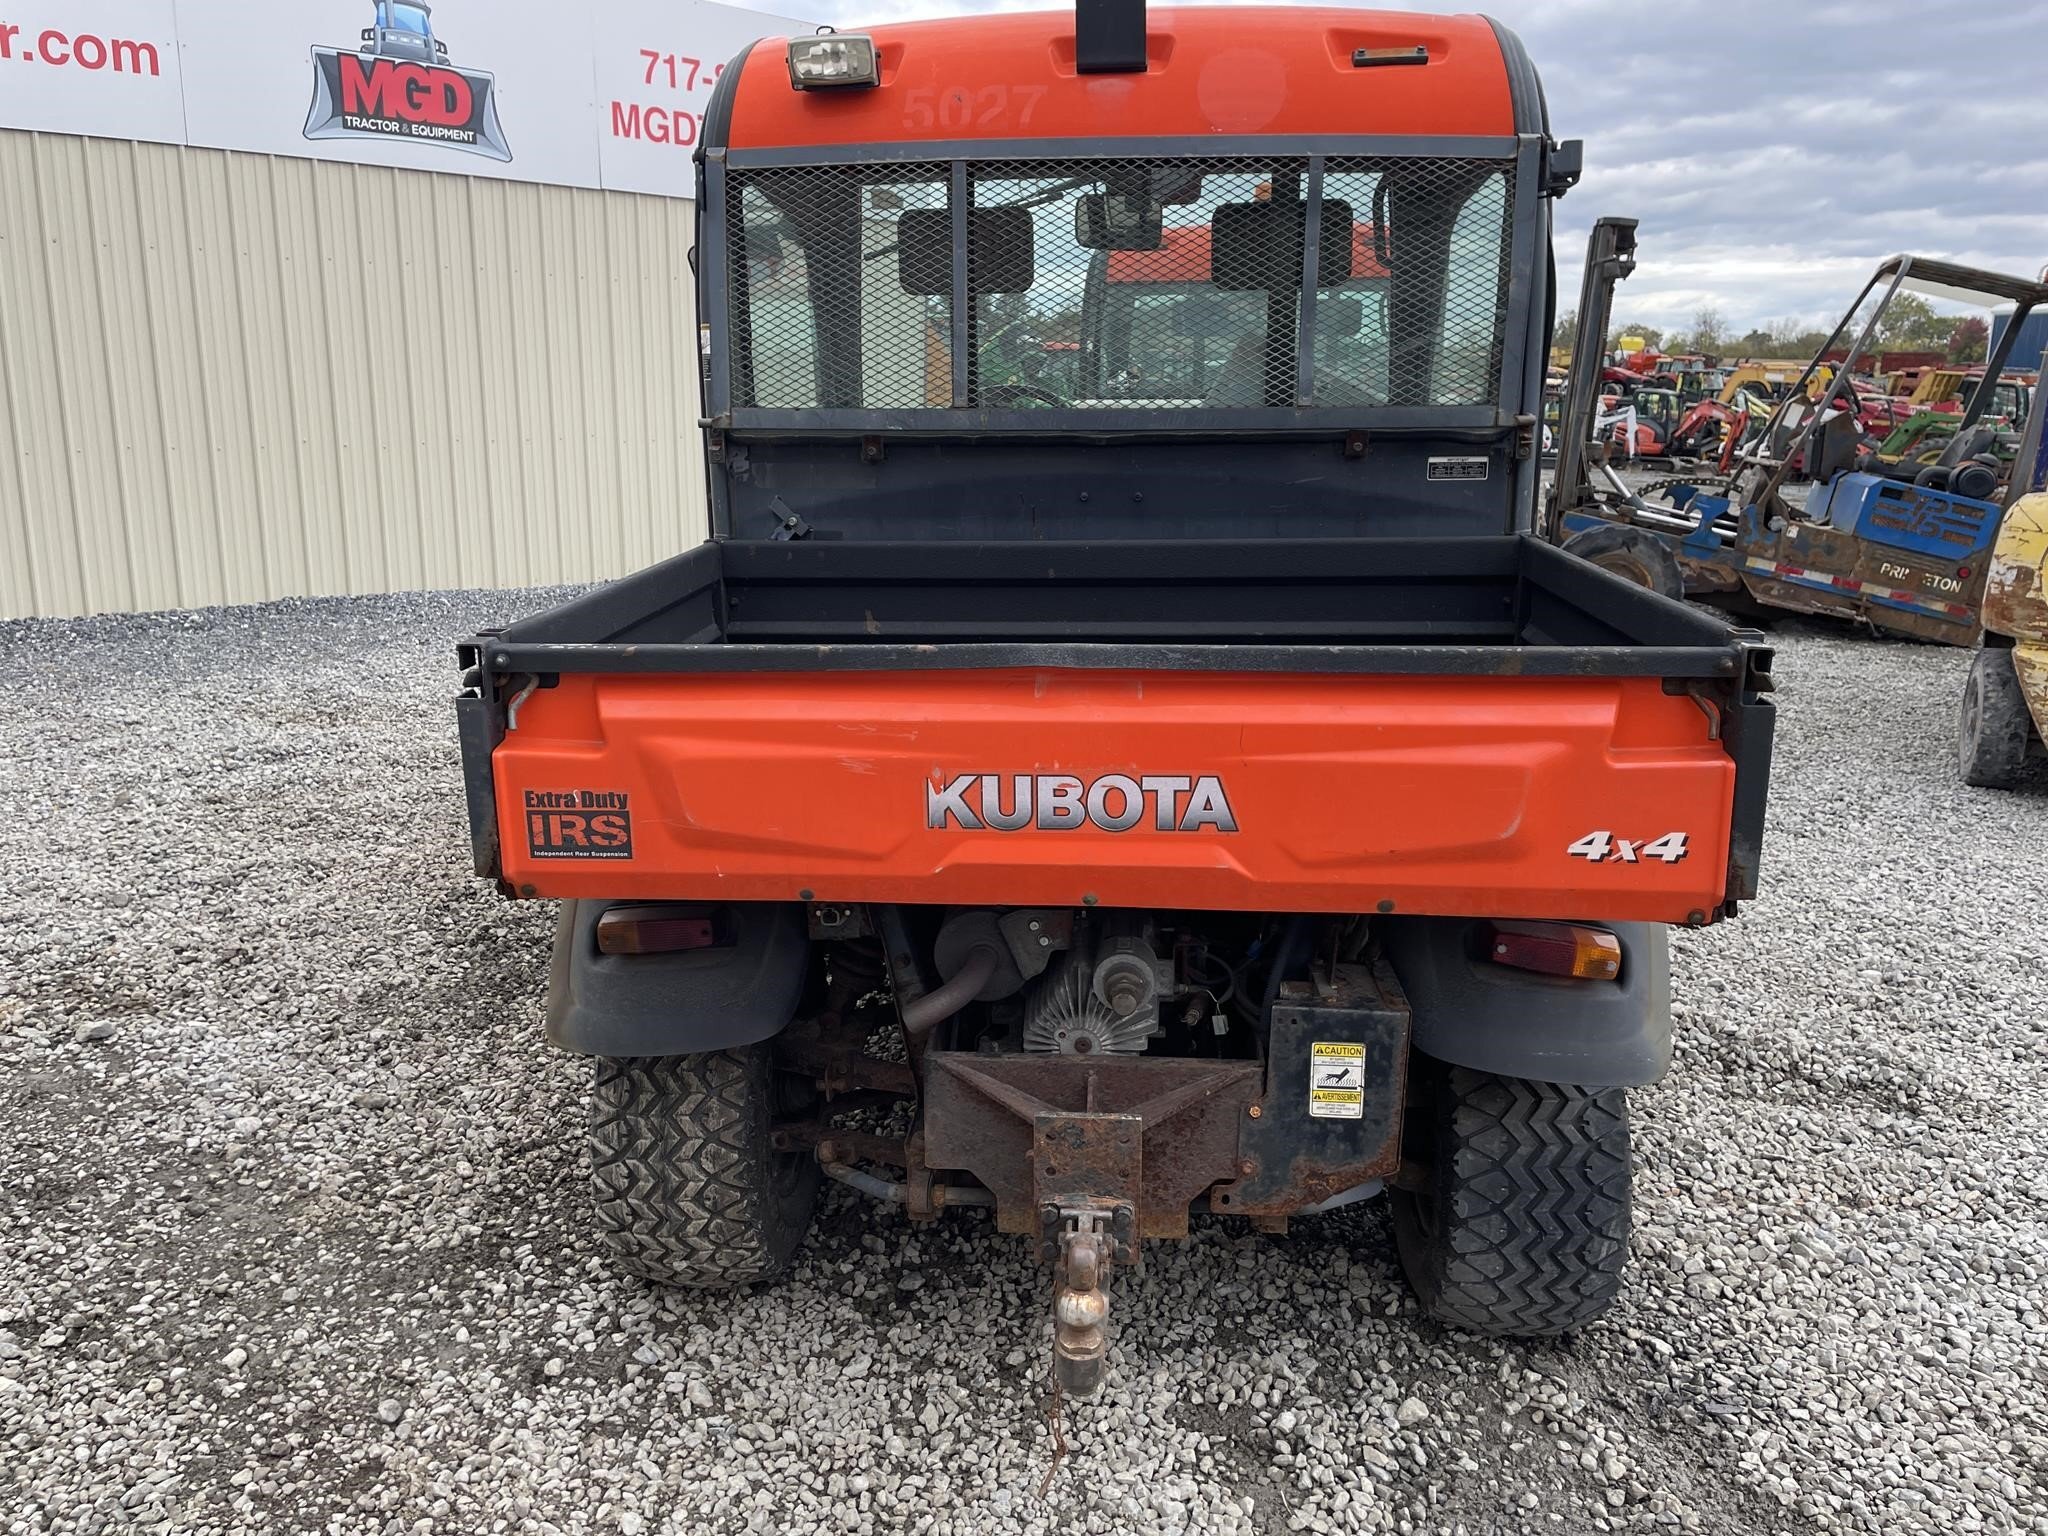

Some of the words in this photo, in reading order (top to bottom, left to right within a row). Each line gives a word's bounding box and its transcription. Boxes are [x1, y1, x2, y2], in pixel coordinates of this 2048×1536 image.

[0, 24, 160, 76] r.com
[640, 48, 725, 91] 717-
[338, 53, 472, 127] MGD
[902, 85, 1048, 131] 5027
[345, 116, 400, 133] TRACTOR
[402, 123, 409, 134] &
[411, 124, 474, 141] EQUIPMENT
[611, 101, 703, 146] MGD
[525, 790, 576, 808] Extra
[581, 791, 628, 809] Duty
[927, 774, 1239, 832] KUBOTA
[531, 814, 628, 846] IRS
[1567, 830, 1689, 864] 4x4
[1324, 1046, 1361, 1055] CAUTION
